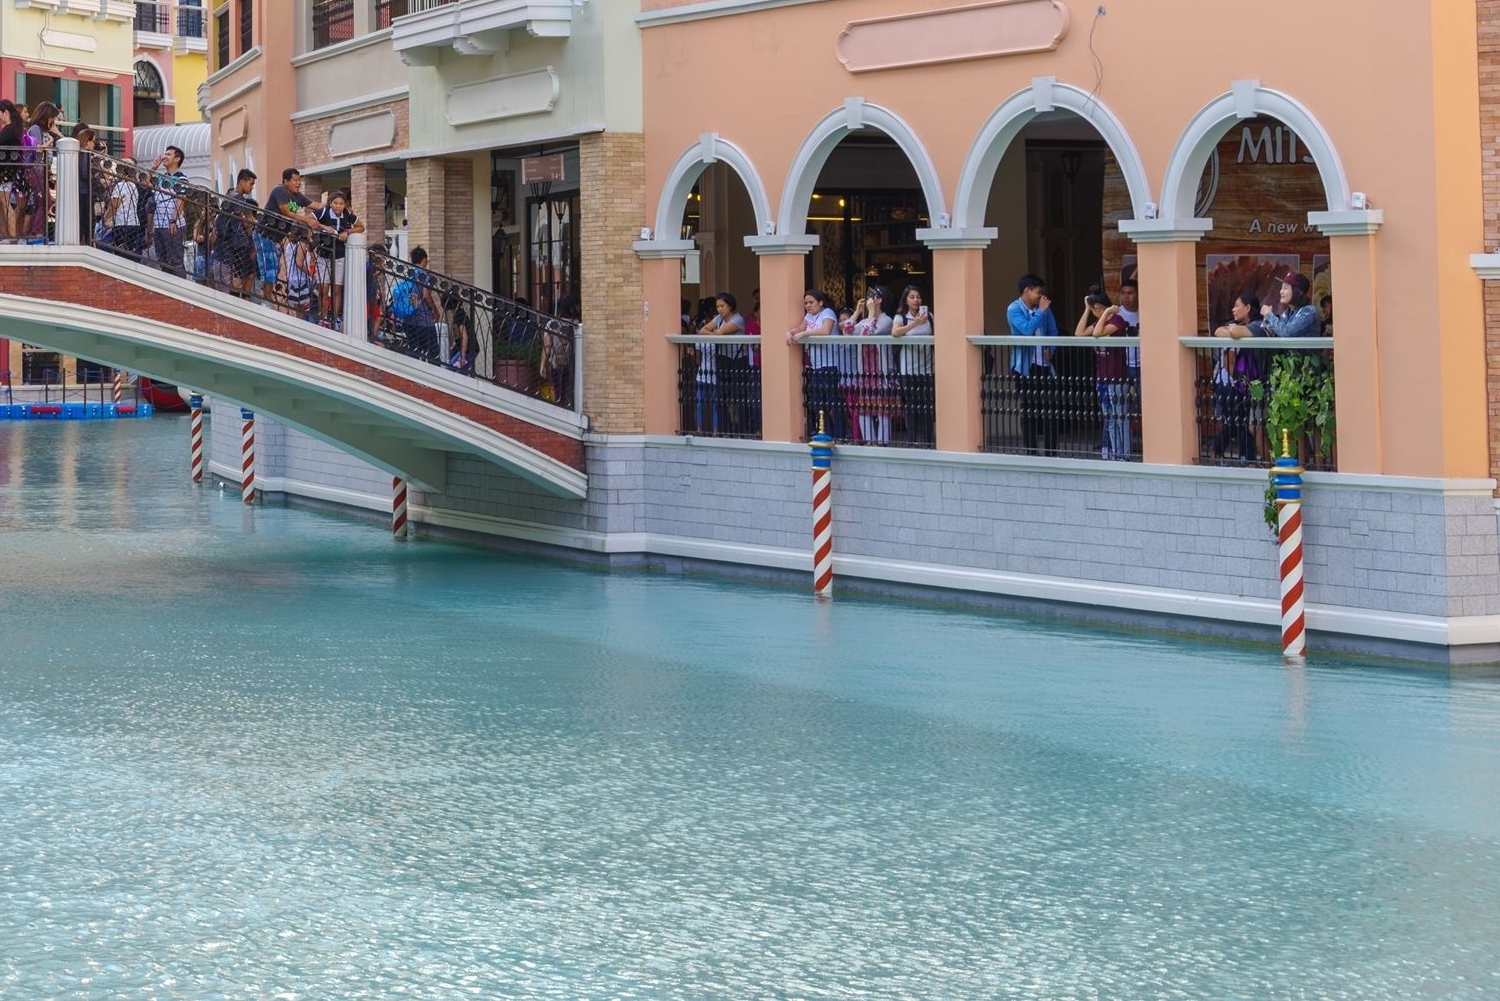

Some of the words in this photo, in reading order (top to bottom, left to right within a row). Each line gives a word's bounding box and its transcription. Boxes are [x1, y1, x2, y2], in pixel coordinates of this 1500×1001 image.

[1237, 125, 1316, 164] MIT
[1249, 218, 1262, 234] A
[1267, 222, 1298, 234] new
[1303, 222, 1315, 234] w
